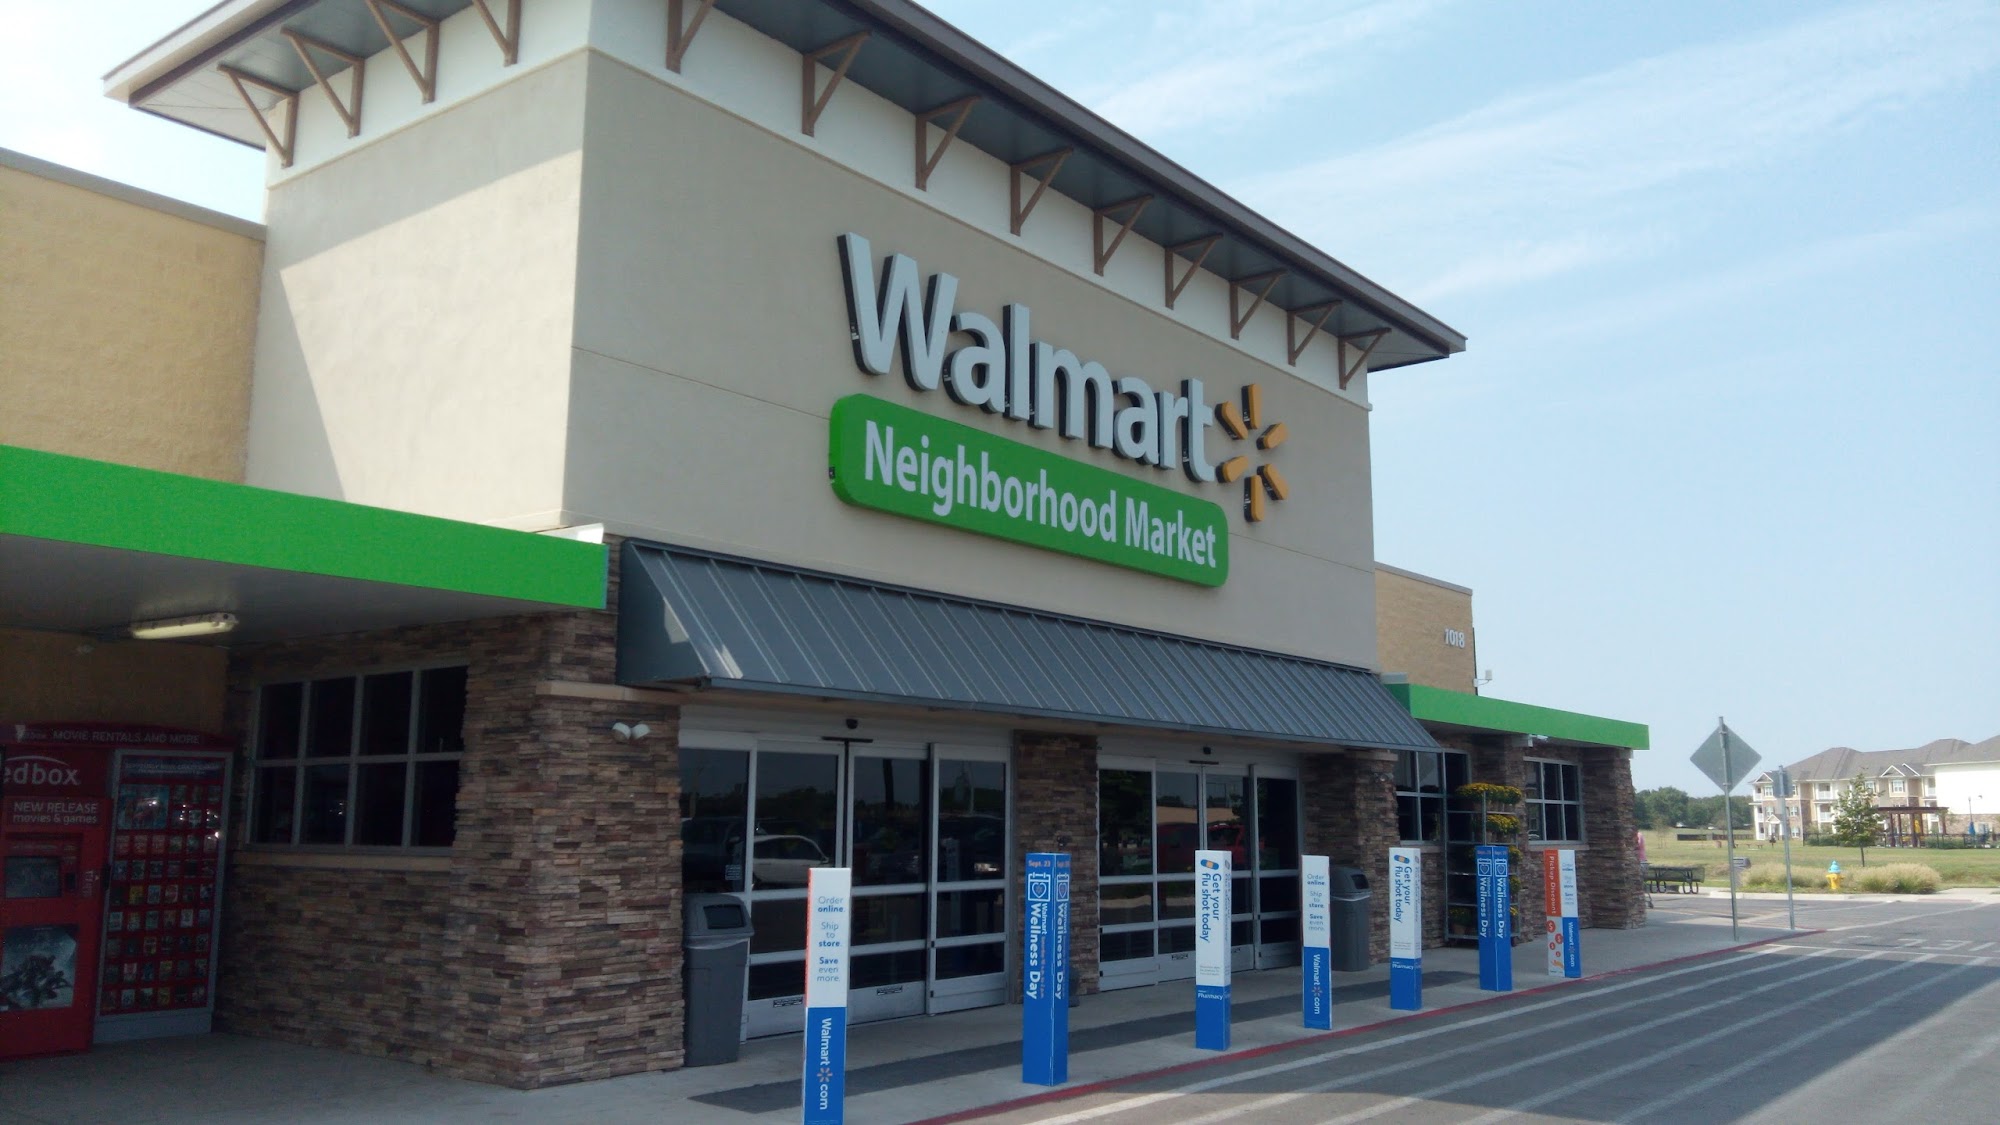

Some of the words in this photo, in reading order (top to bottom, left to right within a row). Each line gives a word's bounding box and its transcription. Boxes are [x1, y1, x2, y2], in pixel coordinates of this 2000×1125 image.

[837, 232, 1216, 483] Walmart
[865, 420, 1117, 543] Neighborhood
[1125, 497, 1217, 568] Market
[52, 730, 88, 741] MOVIE
[92, 731, 141, 743] RENTALS
[144, 733, 167, 744] AND
[169, 734, 200, 744] MORE
[13, 801, 43, 813] NEW
[46, 802, 98, 814] RELEASE
[12, 813, 51, 823] movies
[53, 813, 61, 823] &
[63, 815, 97, 825] games
[1201, 873, 1211, 887] flu
[1395, 866, 1403, 878] flu
[1404, 866, 1412, 882] Get
[1212, 873, 1222, 893] Get
[1394, 879, 1403, 897] shot
[818, 896, 844, 905] Order
[1202, 889, 1211, 910] shot
[1403, 885, 1411, 905] your
[1210, 896, 1220, 921] your
[1393, 900, 1404, 923] today
[821, 921, 839, 931] Ship
[1030, 902, 1041, 966] Wellness
[1057, 903, 1065, 967] Wellness
[1199, 913, 1211, 943] today
[1480, 920, 1488, 938] Day
[1497, 920, 1505, 939] Day
[819, 956, 839, 964] Save
[1313, 953, 1321, 986] Walmart
[1026, 970, 1041, 1000] Day
[1055, 971, 1064, 1000] Day
[819, 1017, 832, 1066] Walmart
